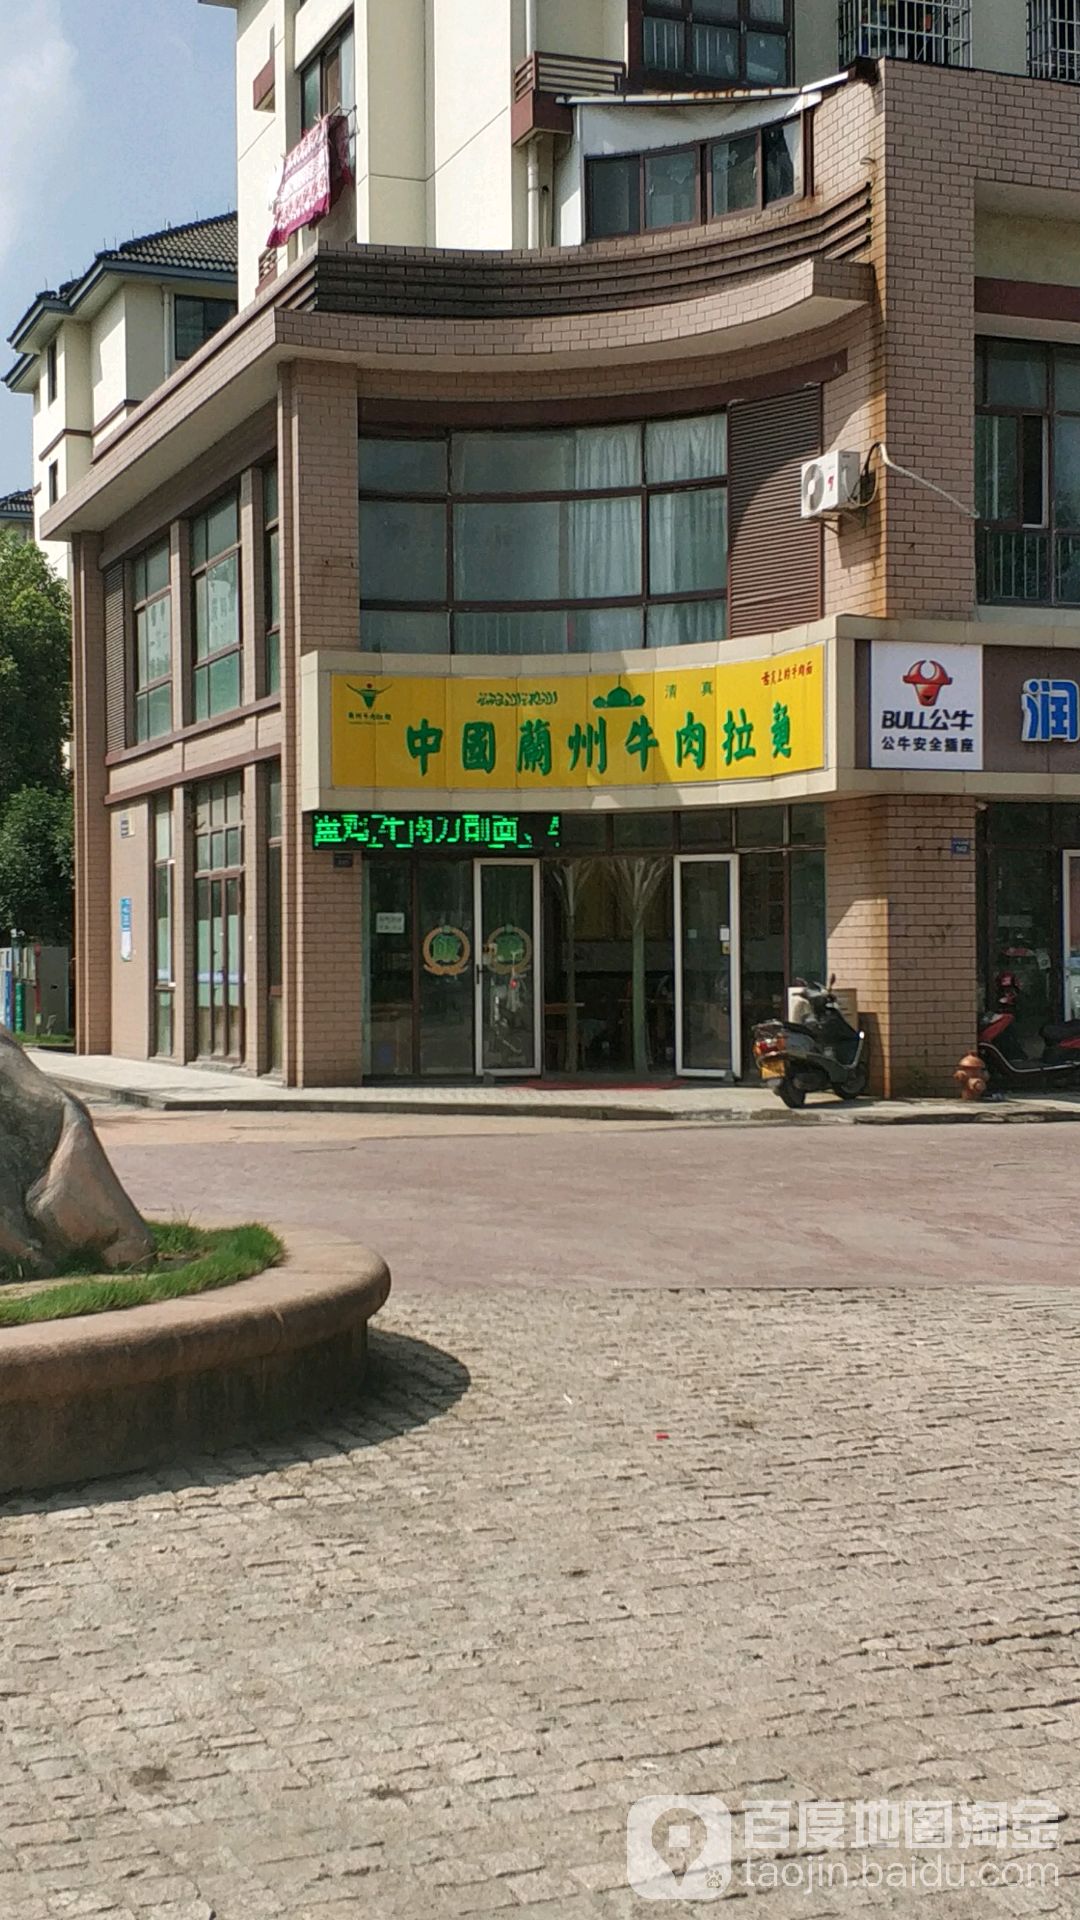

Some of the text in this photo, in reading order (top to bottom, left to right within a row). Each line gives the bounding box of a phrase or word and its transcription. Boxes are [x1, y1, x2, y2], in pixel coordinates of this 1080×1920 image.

[665, 681, 713, 699] 清真
[1022, 679, 1079, 742] 润
[881, 736, 974, 753] 公牛安全插座
